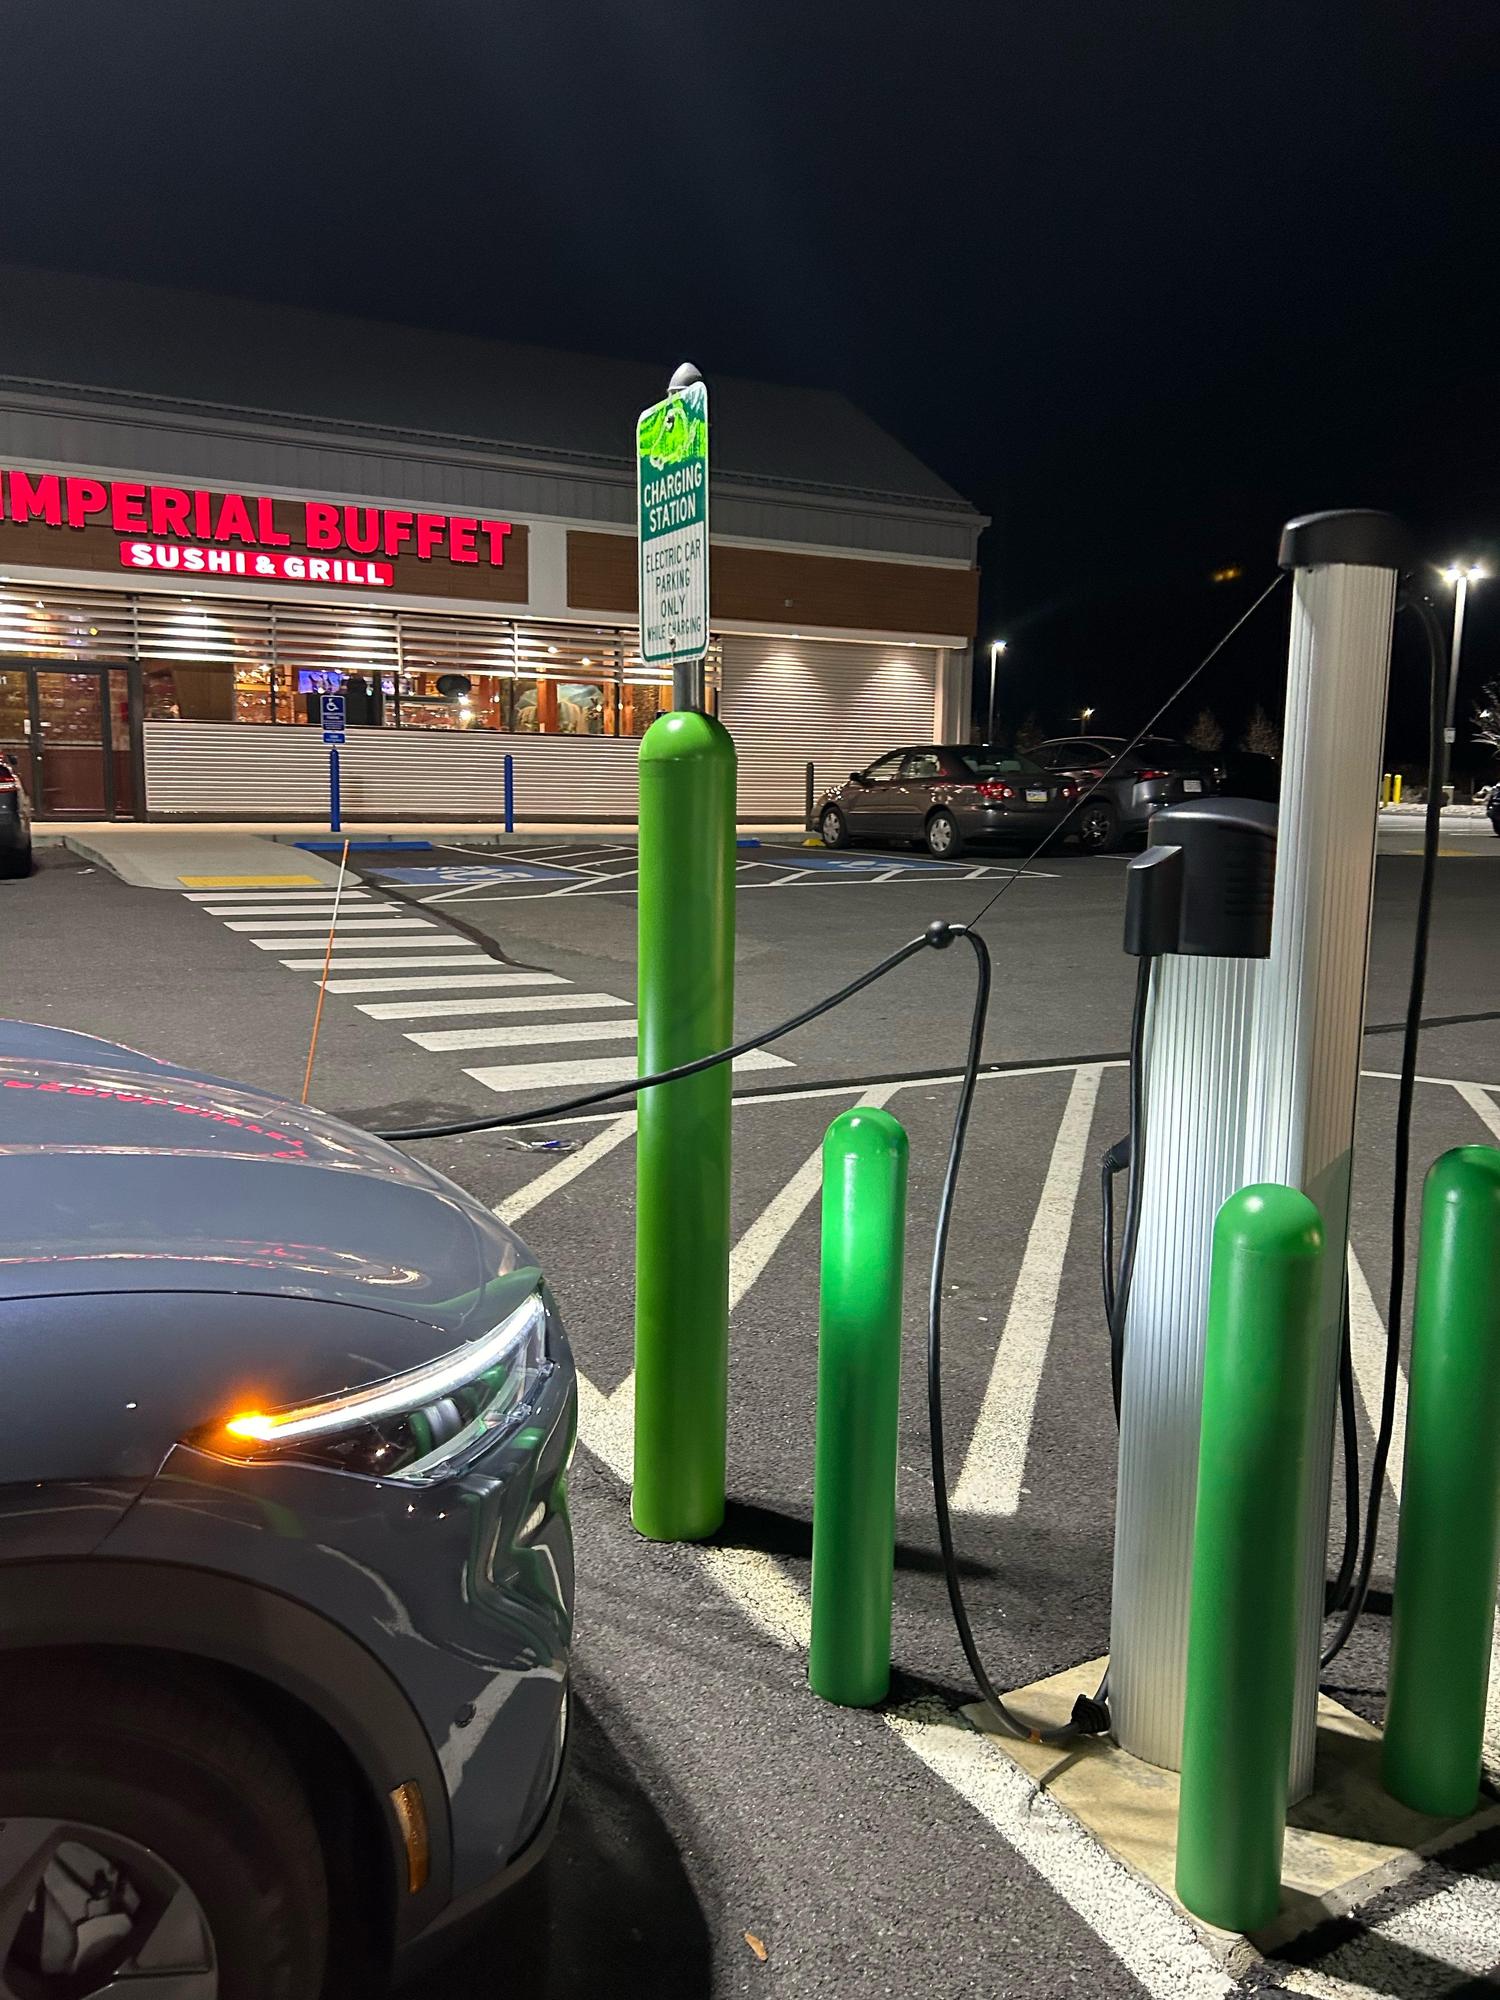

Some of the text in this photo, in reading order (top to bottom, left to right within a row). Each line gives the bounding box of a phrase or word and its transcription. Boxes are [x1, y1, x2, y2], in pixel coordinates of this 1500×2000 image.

[643, 462, 703, 508] CHARGING
[0, 470, 512, 566] MPERIAL BUFFET
[649, 492, 696, 533] STATION
[130, 543, 385, 585] SUSHI & GRILL
[646, 538, 701, 573] ELECTRIC CAR
[656, 567, 690, 595] PARKING
[660, 594, 686, 618] ONLY
[647, 616, 701, 641] WHILE CHARGING
